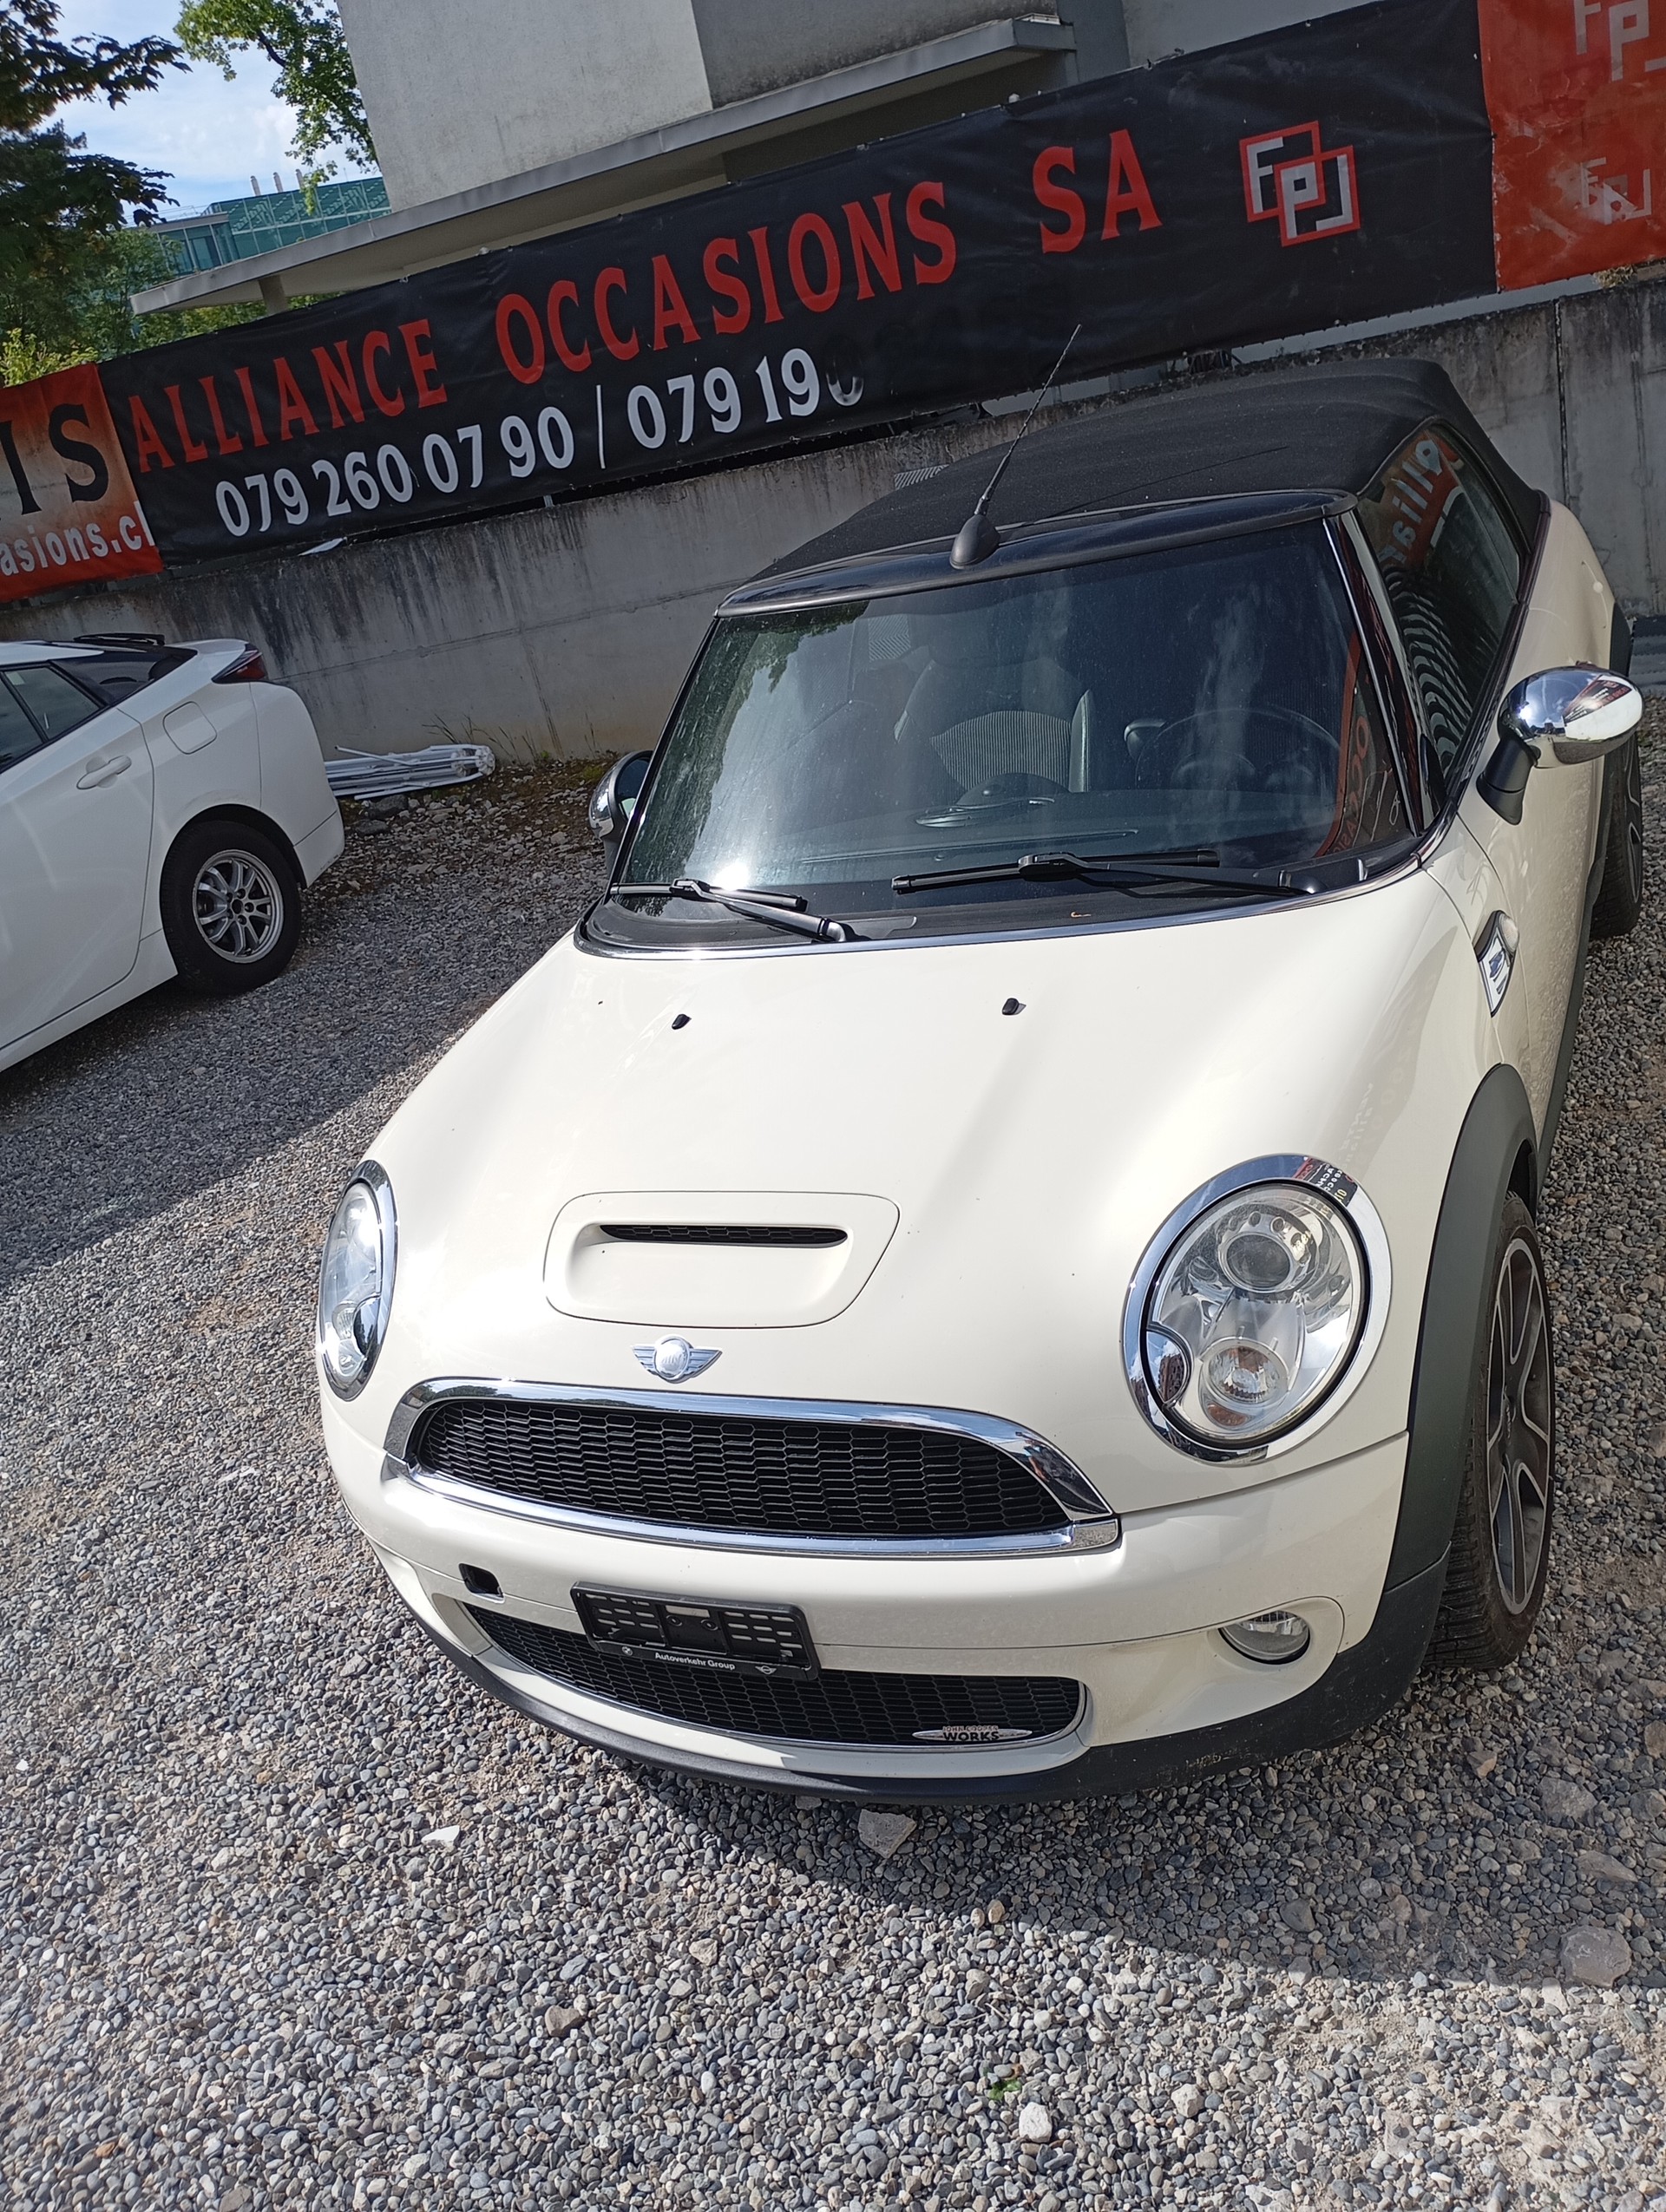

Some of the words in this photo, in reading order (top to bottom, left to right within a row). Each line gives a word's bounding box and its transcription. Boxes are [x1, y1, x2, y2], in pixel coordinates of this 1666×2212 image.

[128, 318, 448, 473] ALLIANCE
[495, 181, 956, 384] OCCASIONS
[1033, 128, 1163, 253] SA
[0, 403, 108, 515] IS
[215, 468, 310, 537] 079
[312, 443, 414, 517] 260
[422, 424, 483, 494] 07
[500, 406, 574, 478] 90
[627, 367, 742, 449] 079
[654, 1652, 706, 1666] Autoverkehr
[707, 1659, 736, 1671] Group
[942, 1731, 1000, 1741] WORKS
